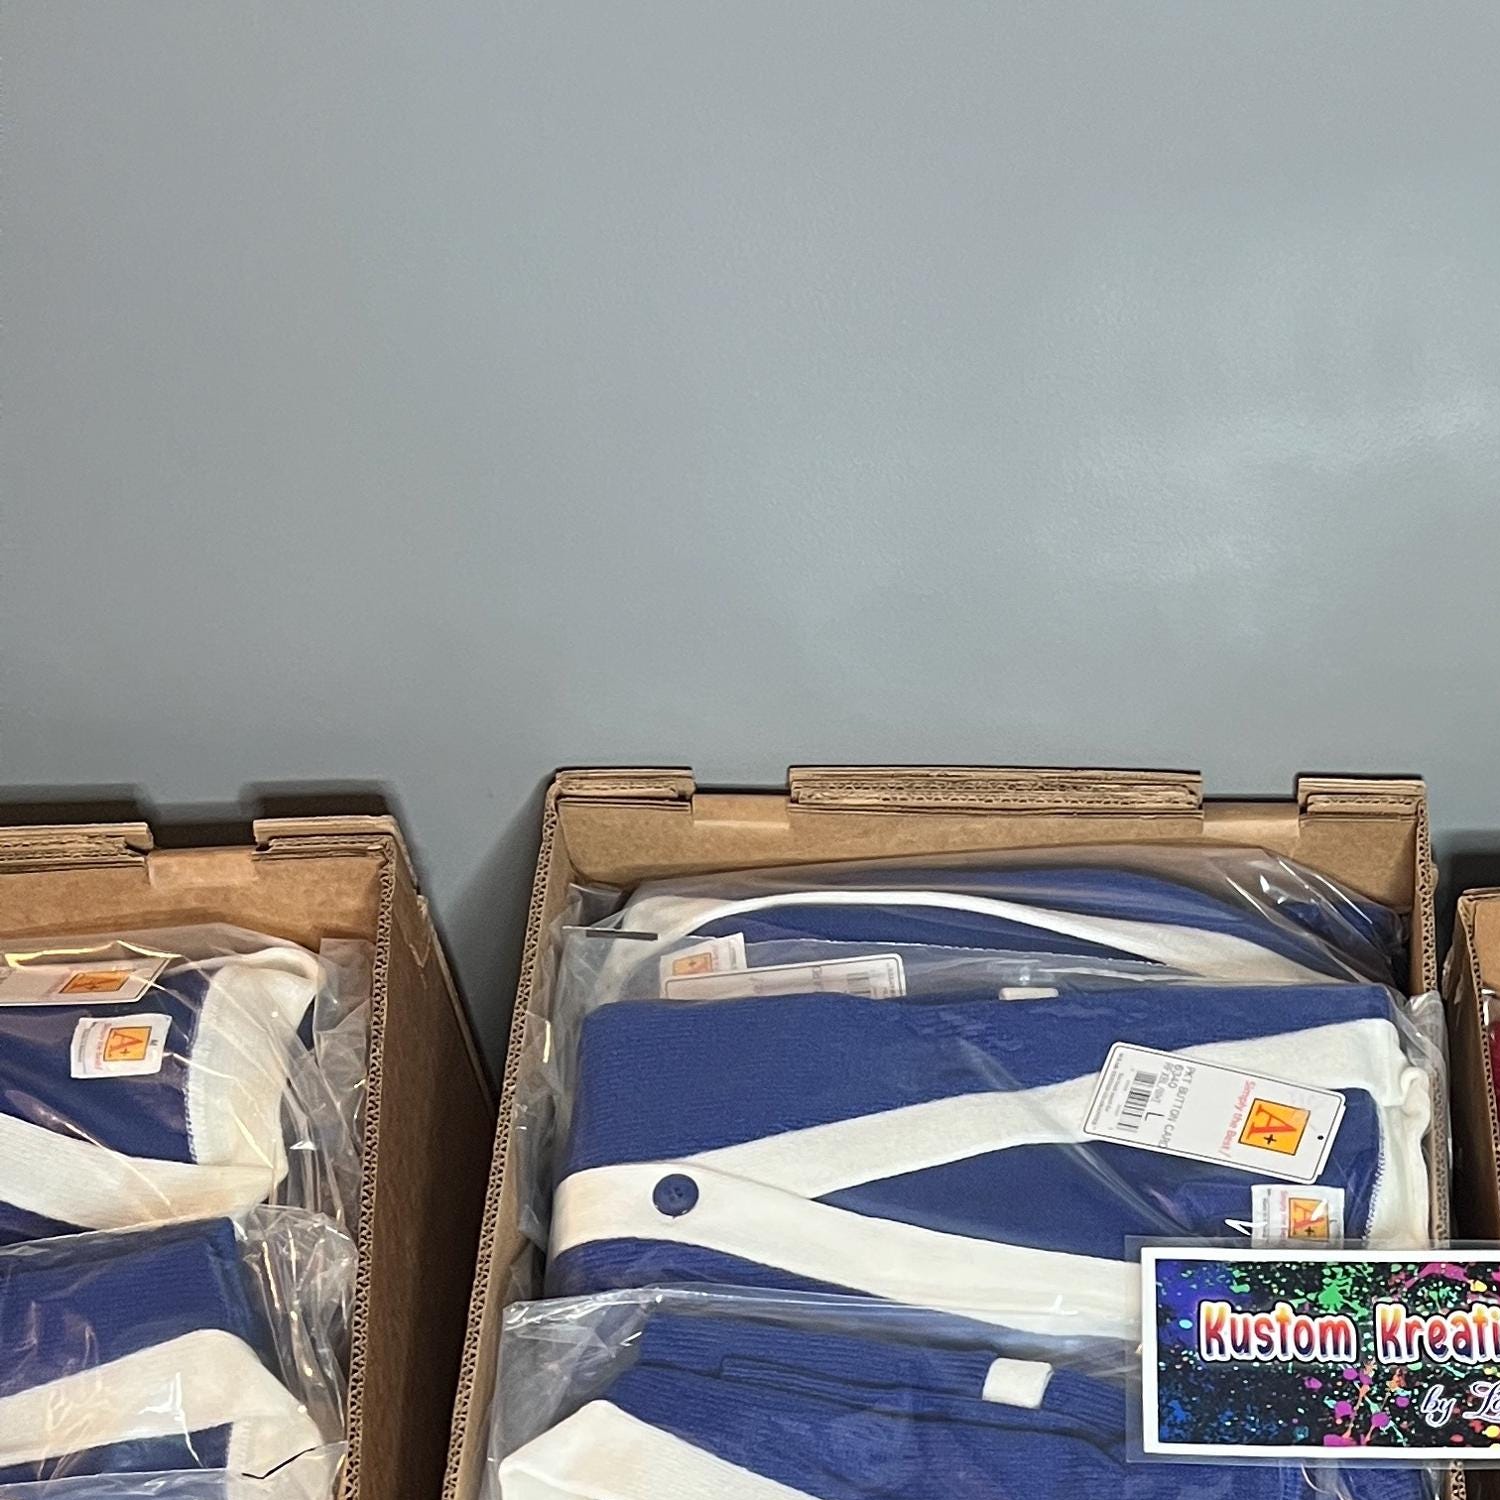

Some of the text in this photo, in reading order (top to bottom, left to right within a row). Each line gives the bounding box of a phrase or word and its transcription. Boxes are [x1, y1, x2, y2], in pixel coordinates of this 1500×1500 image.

[1167, 1063, 1182, 1089] 6340
[1144, 1110, 1163, 1124] L
[1167, 1085, 1187, 1122] BUTTON
[1246, 1104, 1298, 1145] A+
[1200, 1301, 1357, 1362] Kustom
[1421, 1384, 1456, 1427] by
